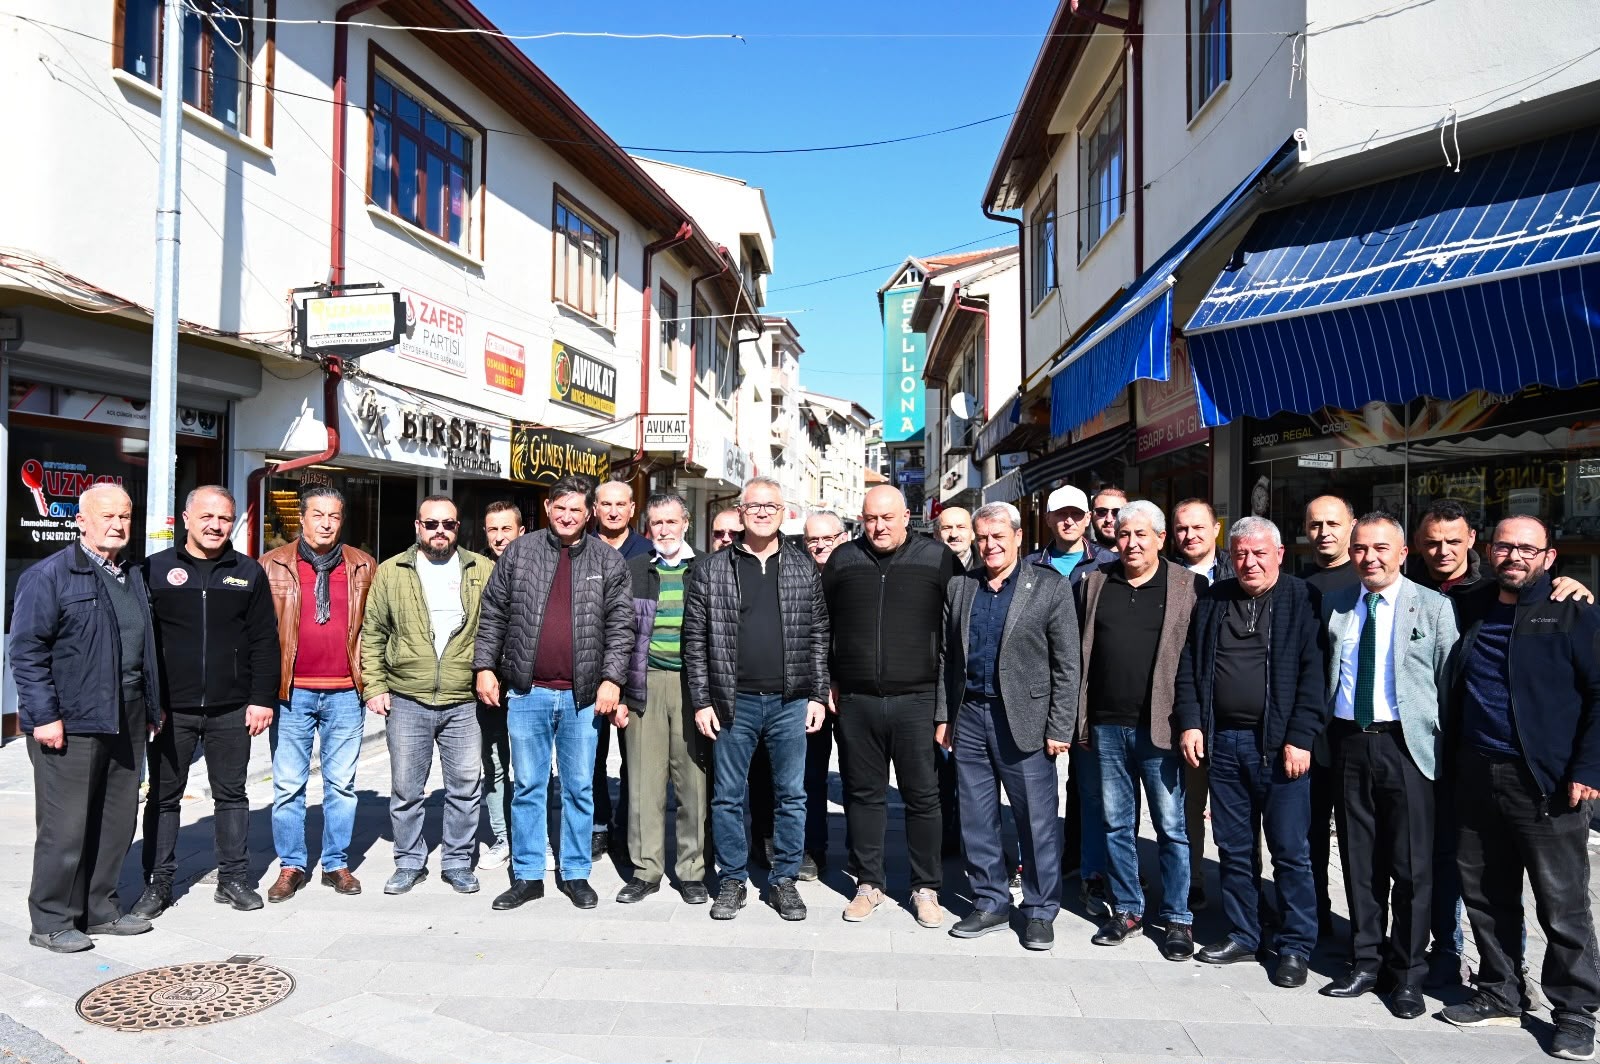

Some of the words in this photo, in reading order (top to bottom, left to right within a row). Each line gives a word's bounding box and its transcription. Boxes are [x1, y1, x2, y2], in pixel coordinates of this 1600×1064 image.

[420, 301, 464, 337] ZAFER
[572, 354, 615, 398] AVUKAT
[900, 298, 916, 433] BELLONA
[646, 420, 686, 434] AVUKAT
[1167, 424, 1174, 442] &
[1252, 433, 1279, 446] sebago
[1283, 427, 1313, 441] REGAL
[1321, 421, 1351, 434] CASIO
[530, 434, 564, 477] GÜNEŞ
[565, 443, 597, 477] KUAFÖR
